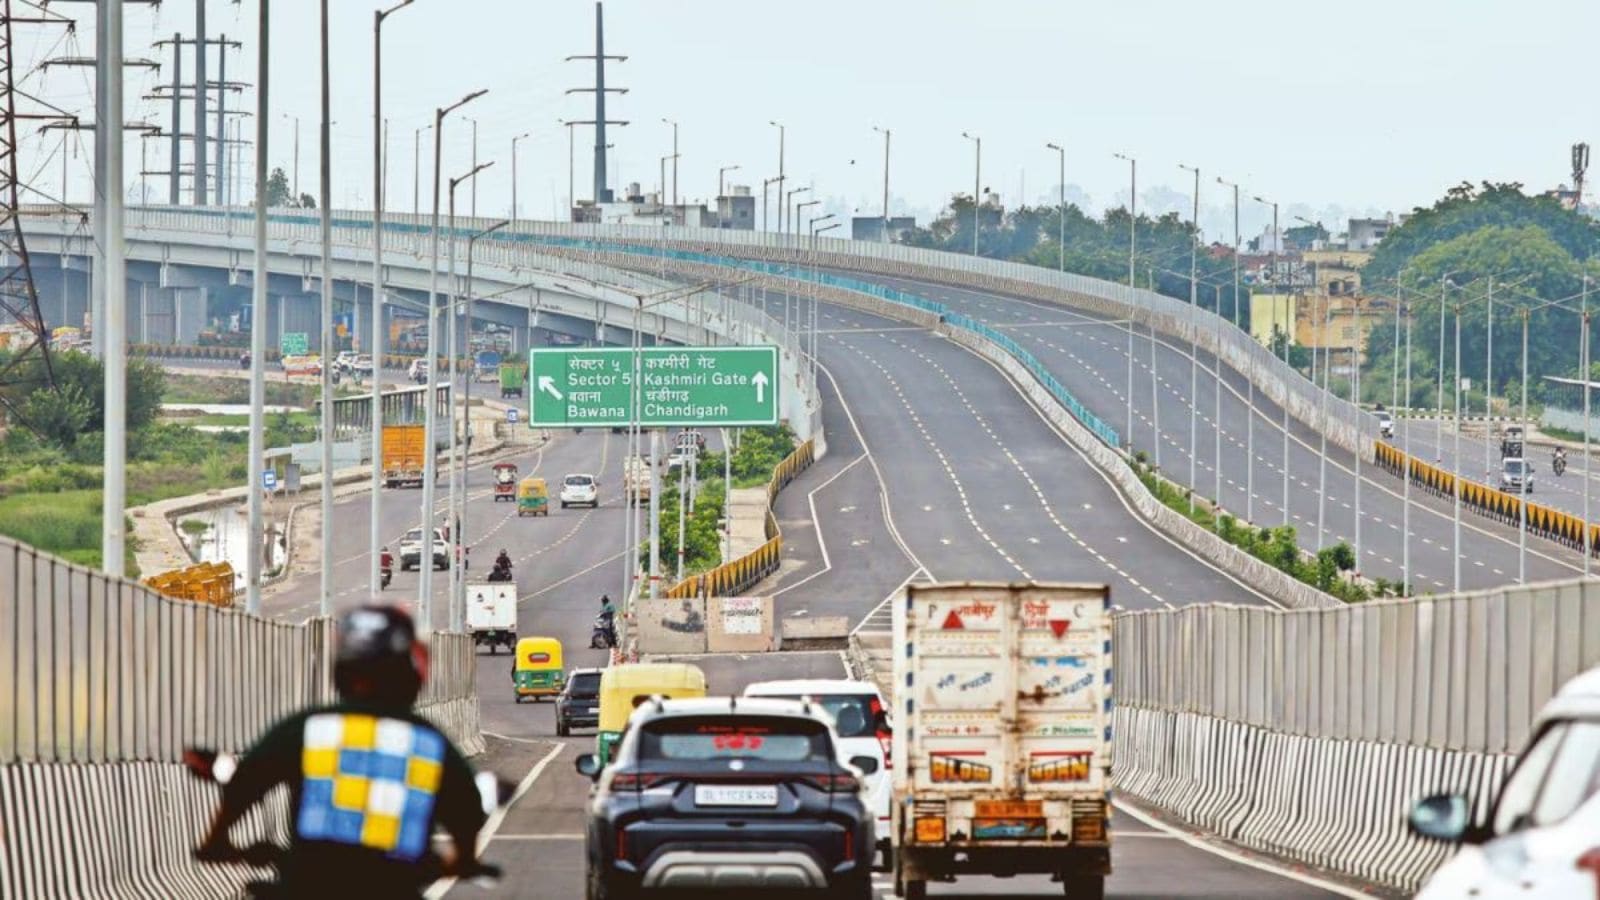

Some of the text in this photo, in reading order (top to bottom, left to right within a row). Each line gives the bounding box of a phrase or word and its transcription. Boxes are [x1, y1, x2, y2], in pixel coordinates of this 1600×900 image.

[697, 354, 716, 369] गेट
[568, 372, 631, 386] Sector 5
[644, 372, 747, 385] Kashmiri Gate
[568, 405, 625, 418] Bawana
[644, 404, 728, 418] Chandigarh
